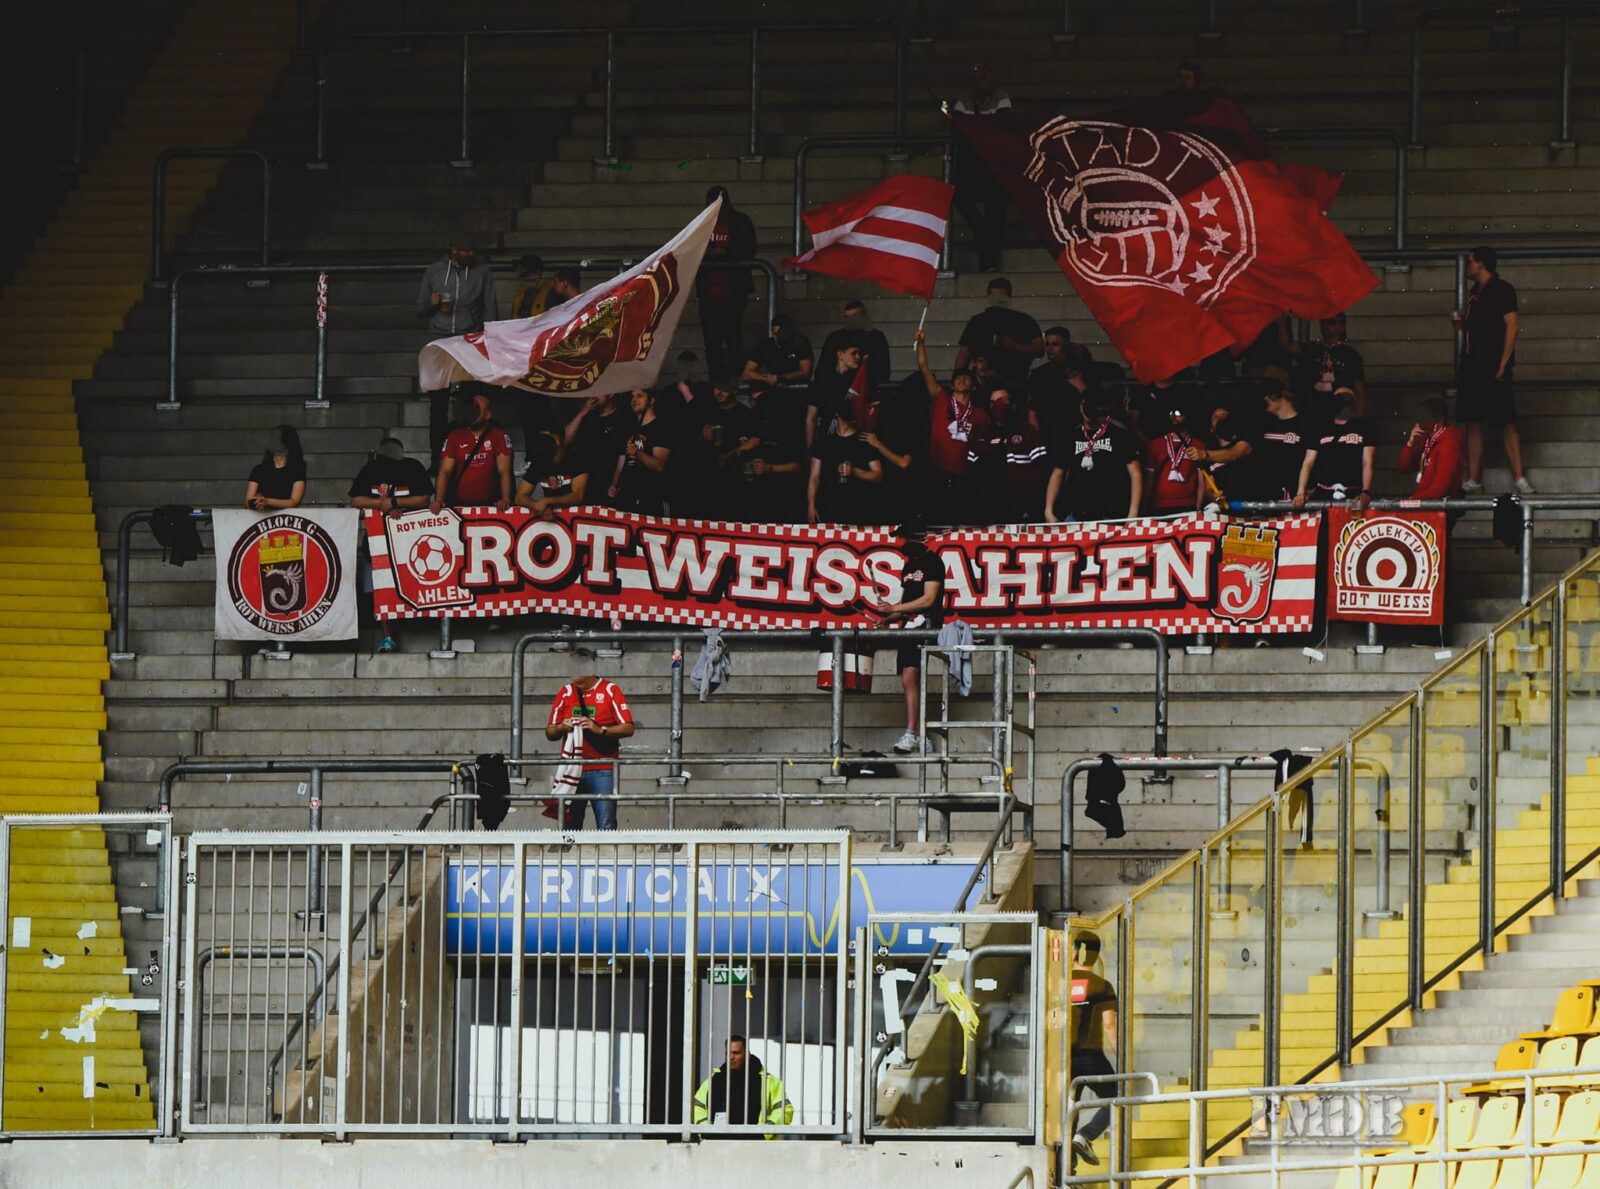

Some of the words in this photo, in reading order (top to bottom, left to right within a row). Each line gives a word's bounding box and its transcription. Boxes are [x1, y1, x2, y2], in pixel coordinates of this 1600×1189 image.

[257, 516, 303, 533] BLOCK
[307, 523, 317, 536] G
[396, 521, 416, 533] ROT
[417, 516, 450, 529] WEISS
[1354, 525, 1423, 553] KOLLEKTIV
[463, 520, 628, 586] ROT
[641, 531, 906, 609] WEISS
[940, 540, 1213, 608] AHLEN
[417, 585, 470, 605] AHLEN
[1339, 592, 1370, 606] ROT
[1378, 594, 1430, 608] WEISS
[235, 598, 258, 622] ROT
[258, 619, 295, 634] WEISS
[298, 598, 332, 631] AHLEN
[456, 867, 782, 903] KARDIOAIX
